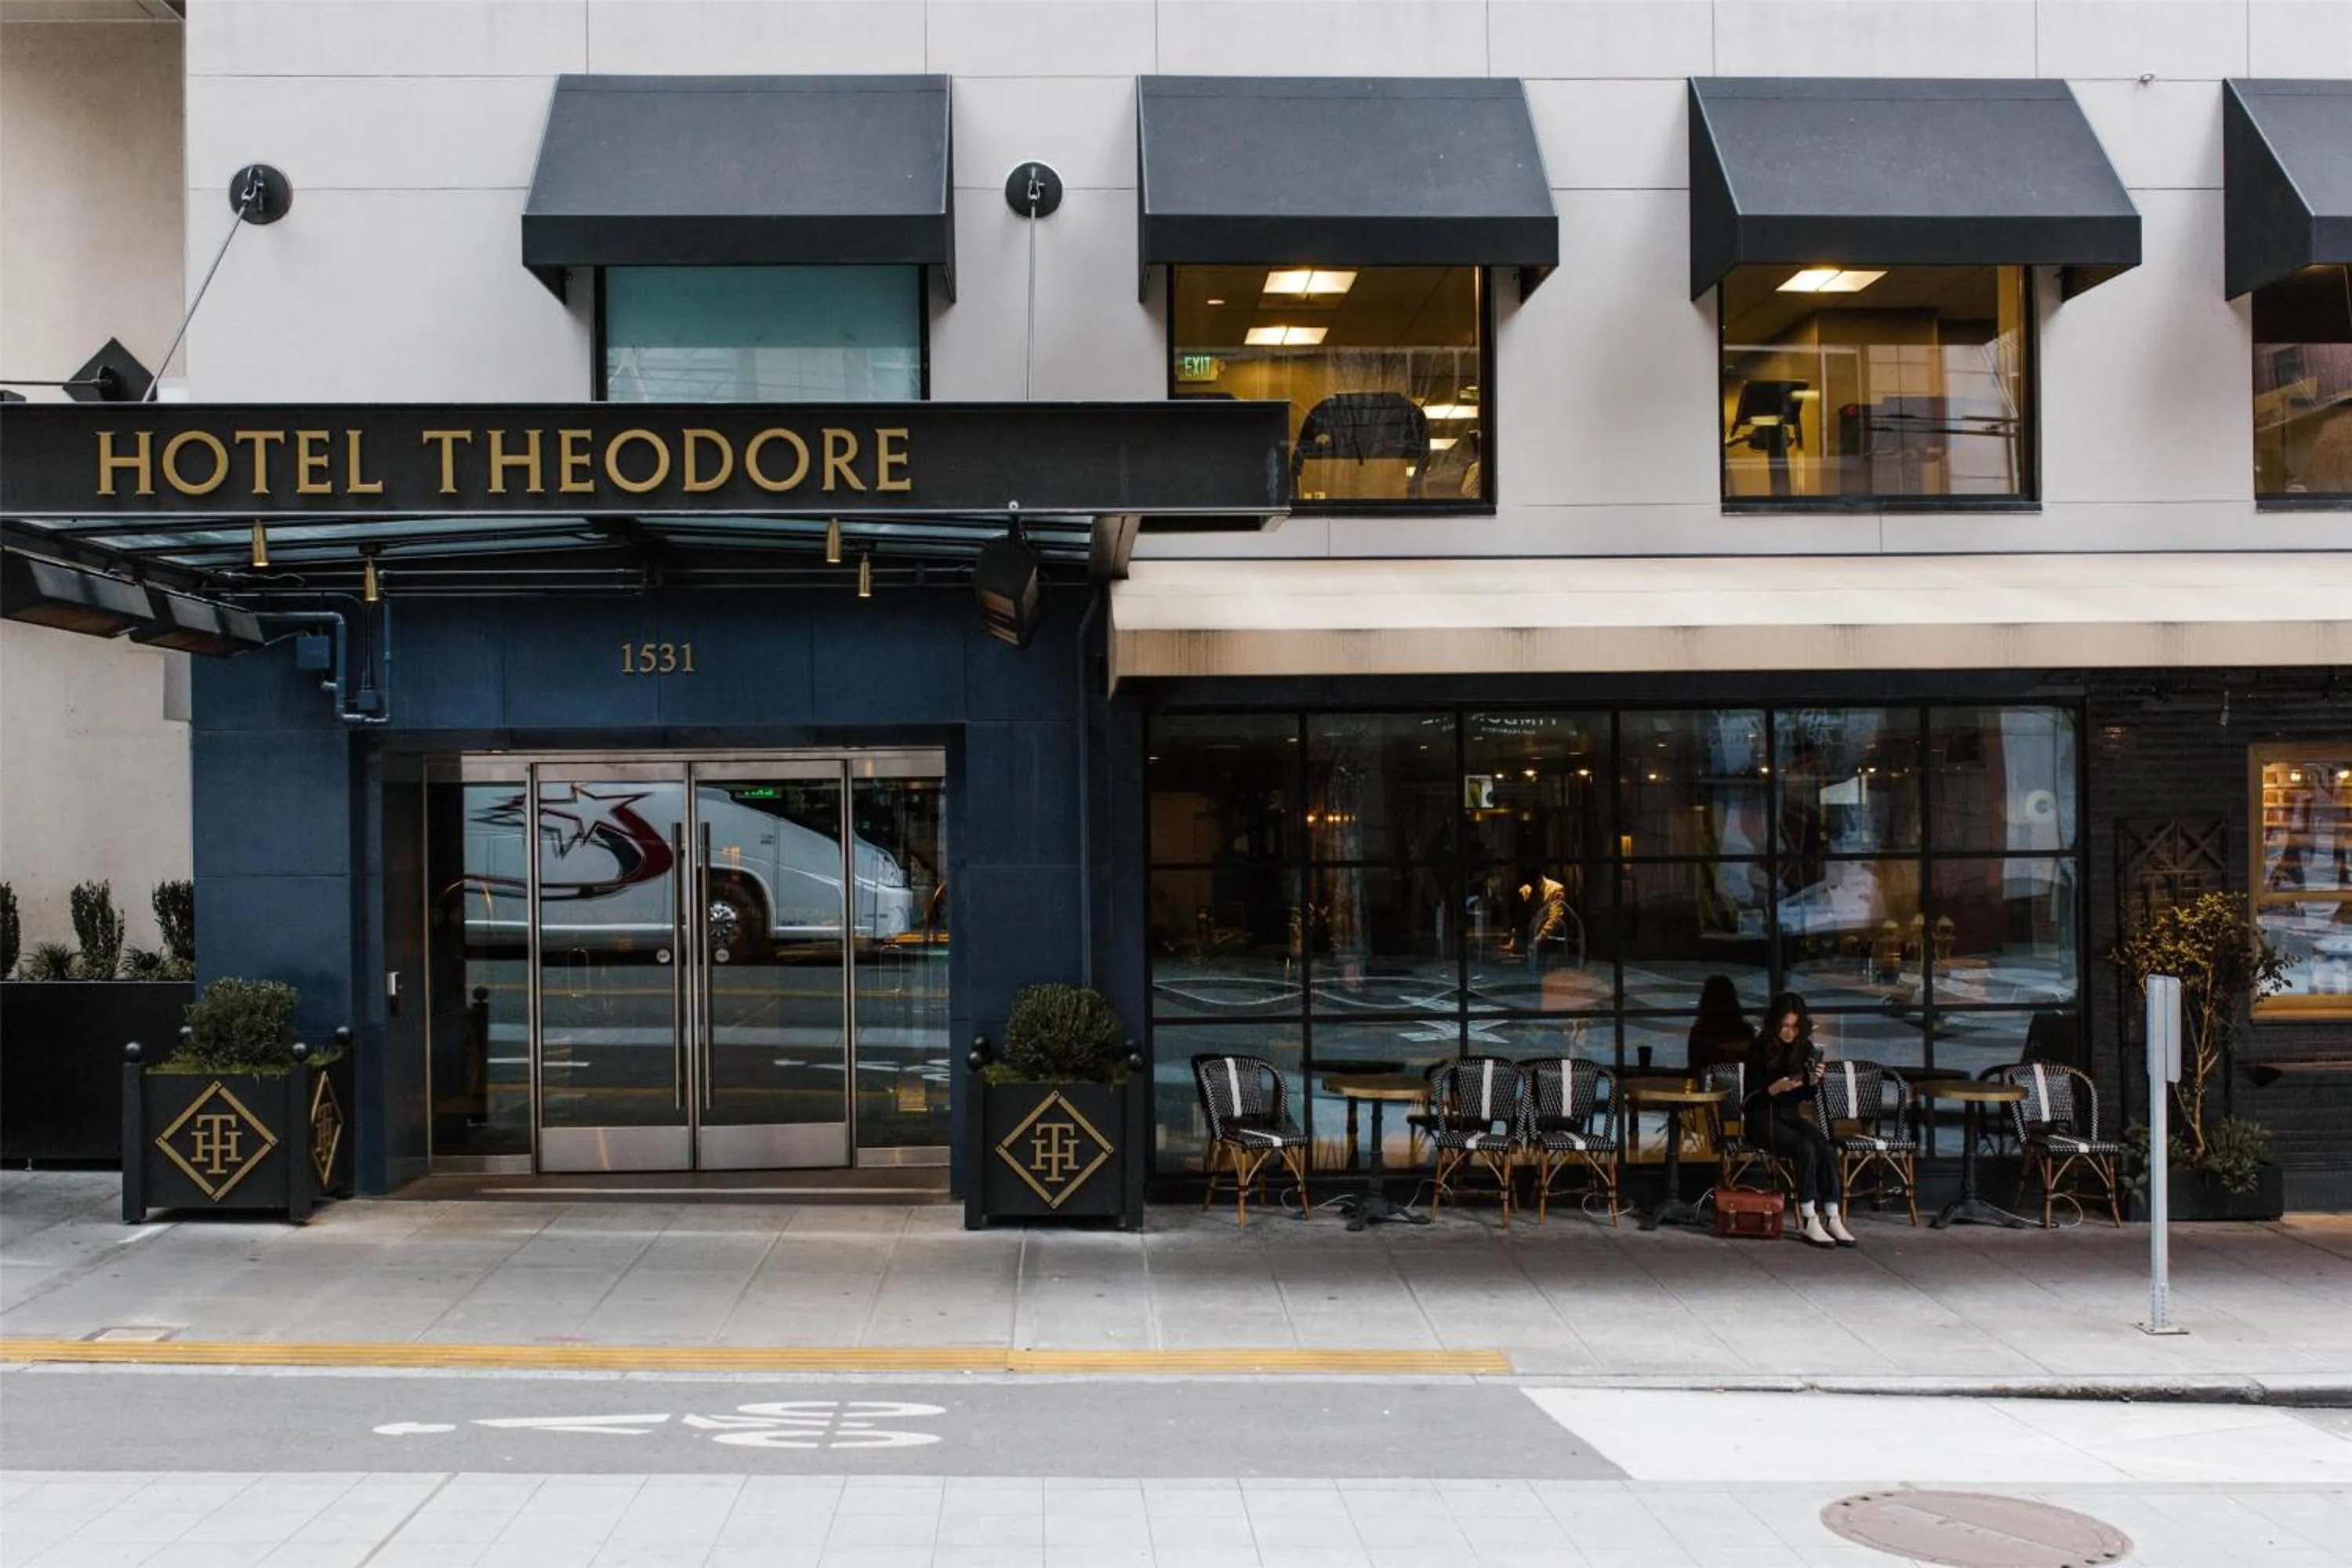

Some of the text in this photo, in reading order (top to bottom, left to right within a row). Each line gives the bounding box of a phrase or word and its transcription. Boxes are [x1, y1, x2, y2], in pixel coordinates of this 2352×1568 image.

[1185, 356, 1211, 377] EXIT
[95, 428, 913, 495] HOTEL THEODORE
[621, 642, 695, 673] 1531
